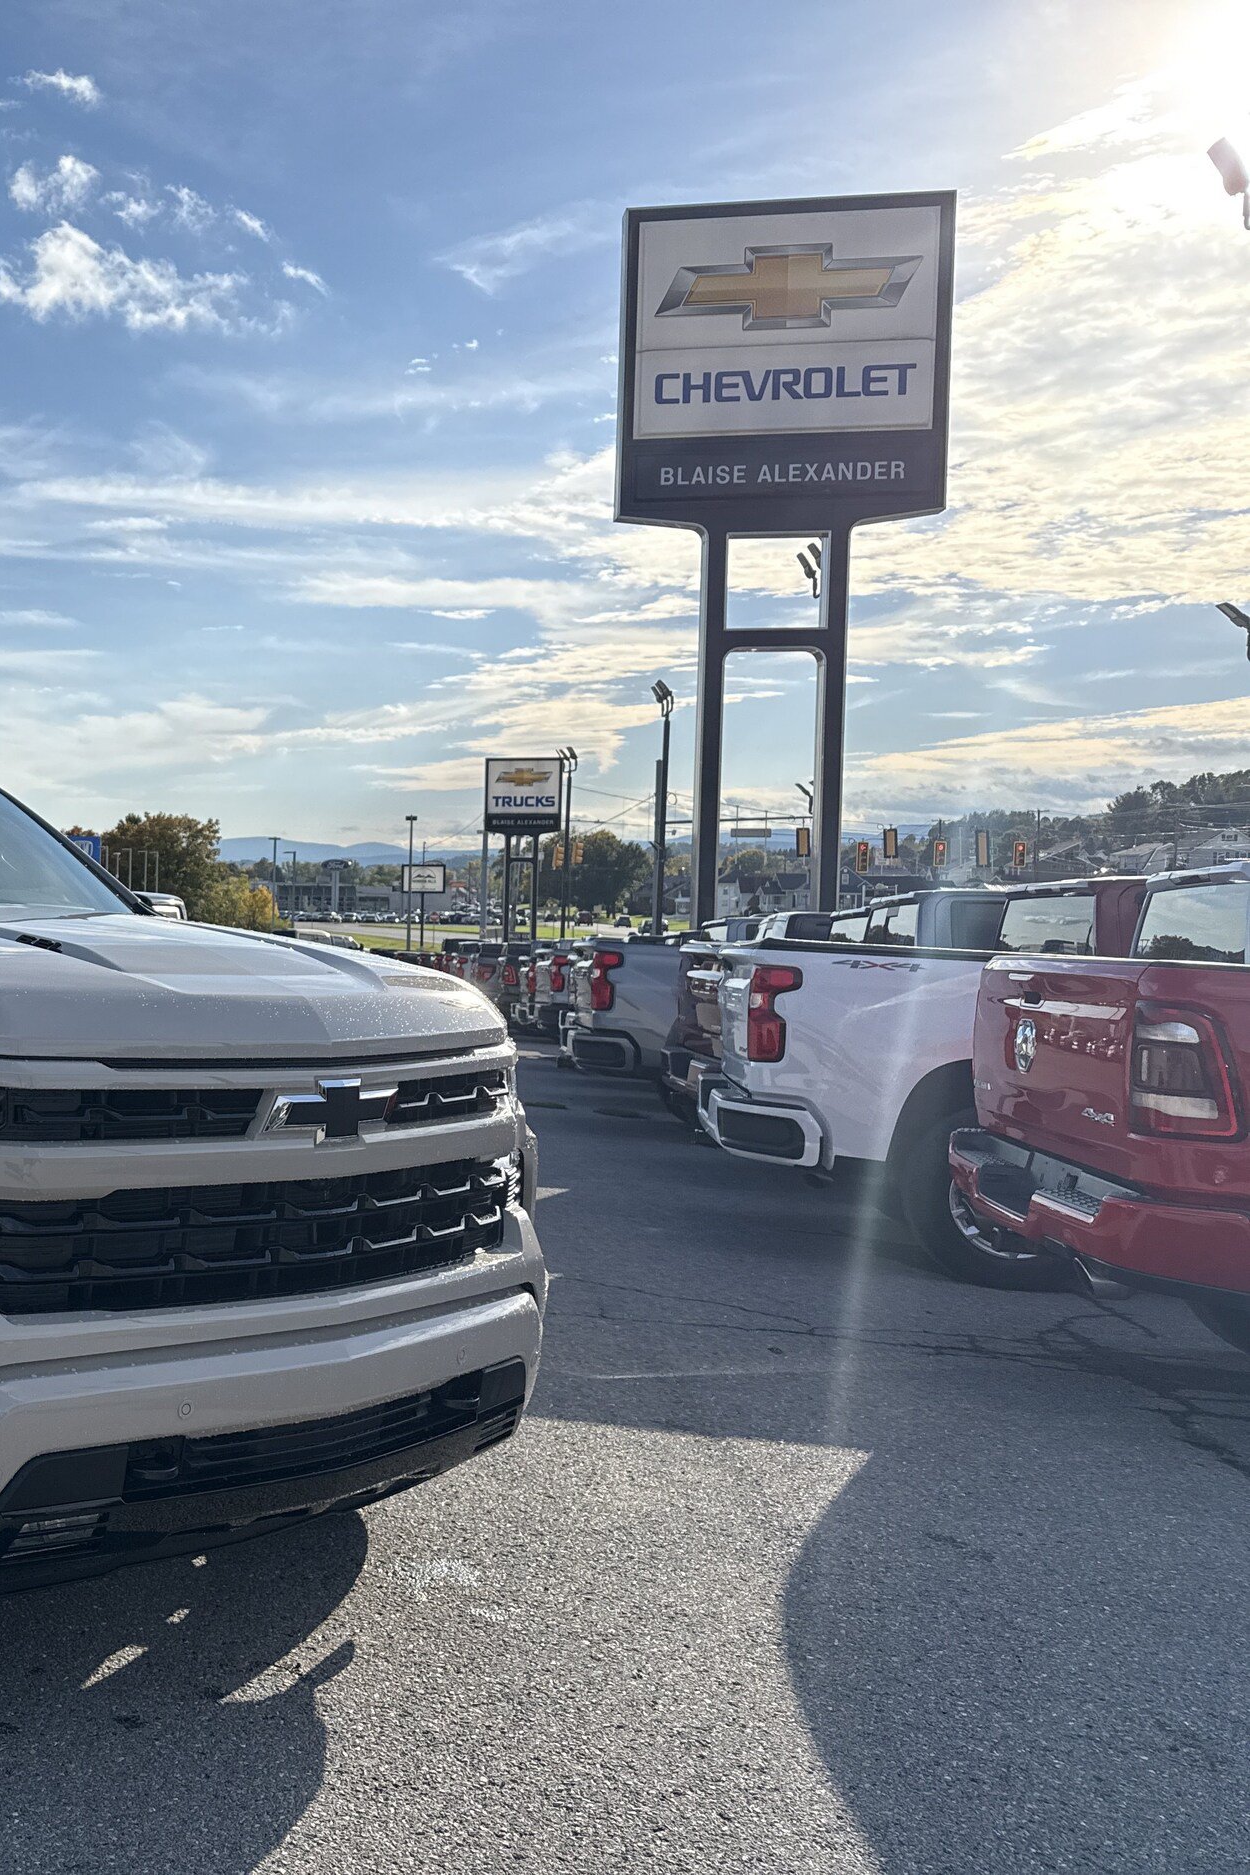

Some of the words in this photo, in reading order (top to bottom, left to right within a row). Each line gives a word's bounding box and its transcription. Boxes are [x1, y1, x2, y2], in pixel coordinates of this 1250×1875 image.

[654, 363, 917, 405] CHEVROLET
[659, 464, 746, 486] BLAISE
[757, 461, 906, 484] ALEXANDER
[492, 795, 556, 807] TRUCKS
[327, 861, 346, 869] Ford
